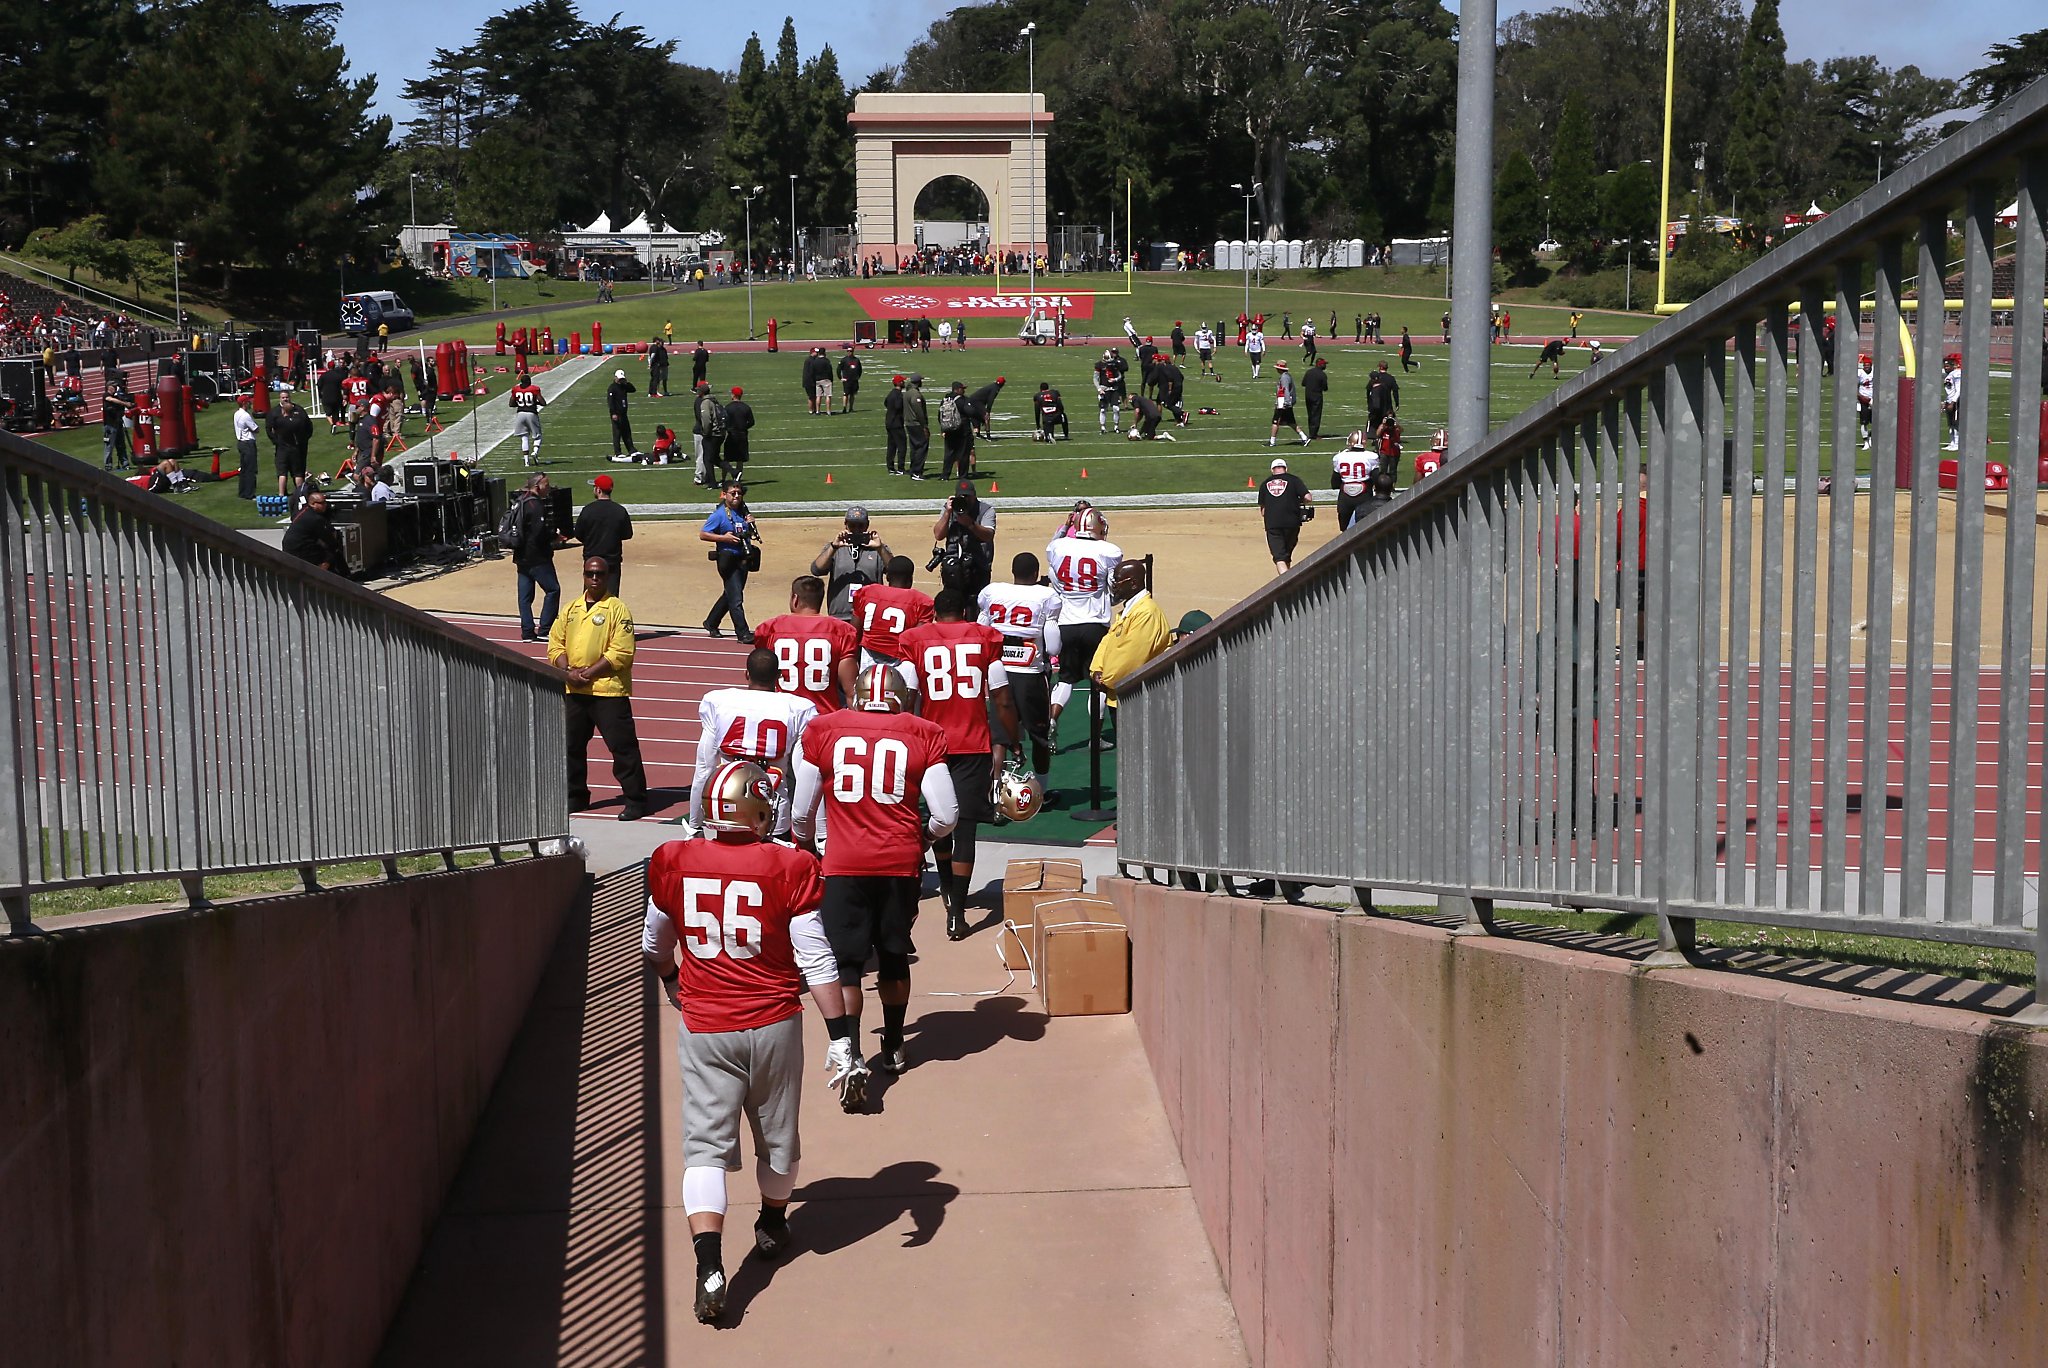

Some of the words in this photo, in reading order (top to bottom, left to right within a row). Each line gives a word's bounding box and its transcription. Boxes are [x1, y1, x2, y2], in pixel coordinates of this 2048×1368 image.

[351, 381, 367, 397] 49
[515, 392, 534, 407] 30
[1057, 555, 1098, 592] 48
[774, 638, 832, 691] 88
[924, 643, 983, 701] 85
[719, 715, 788, 761] 40
[833, 736, 909, 805] 60
[682, 877, 763, 960] 56
